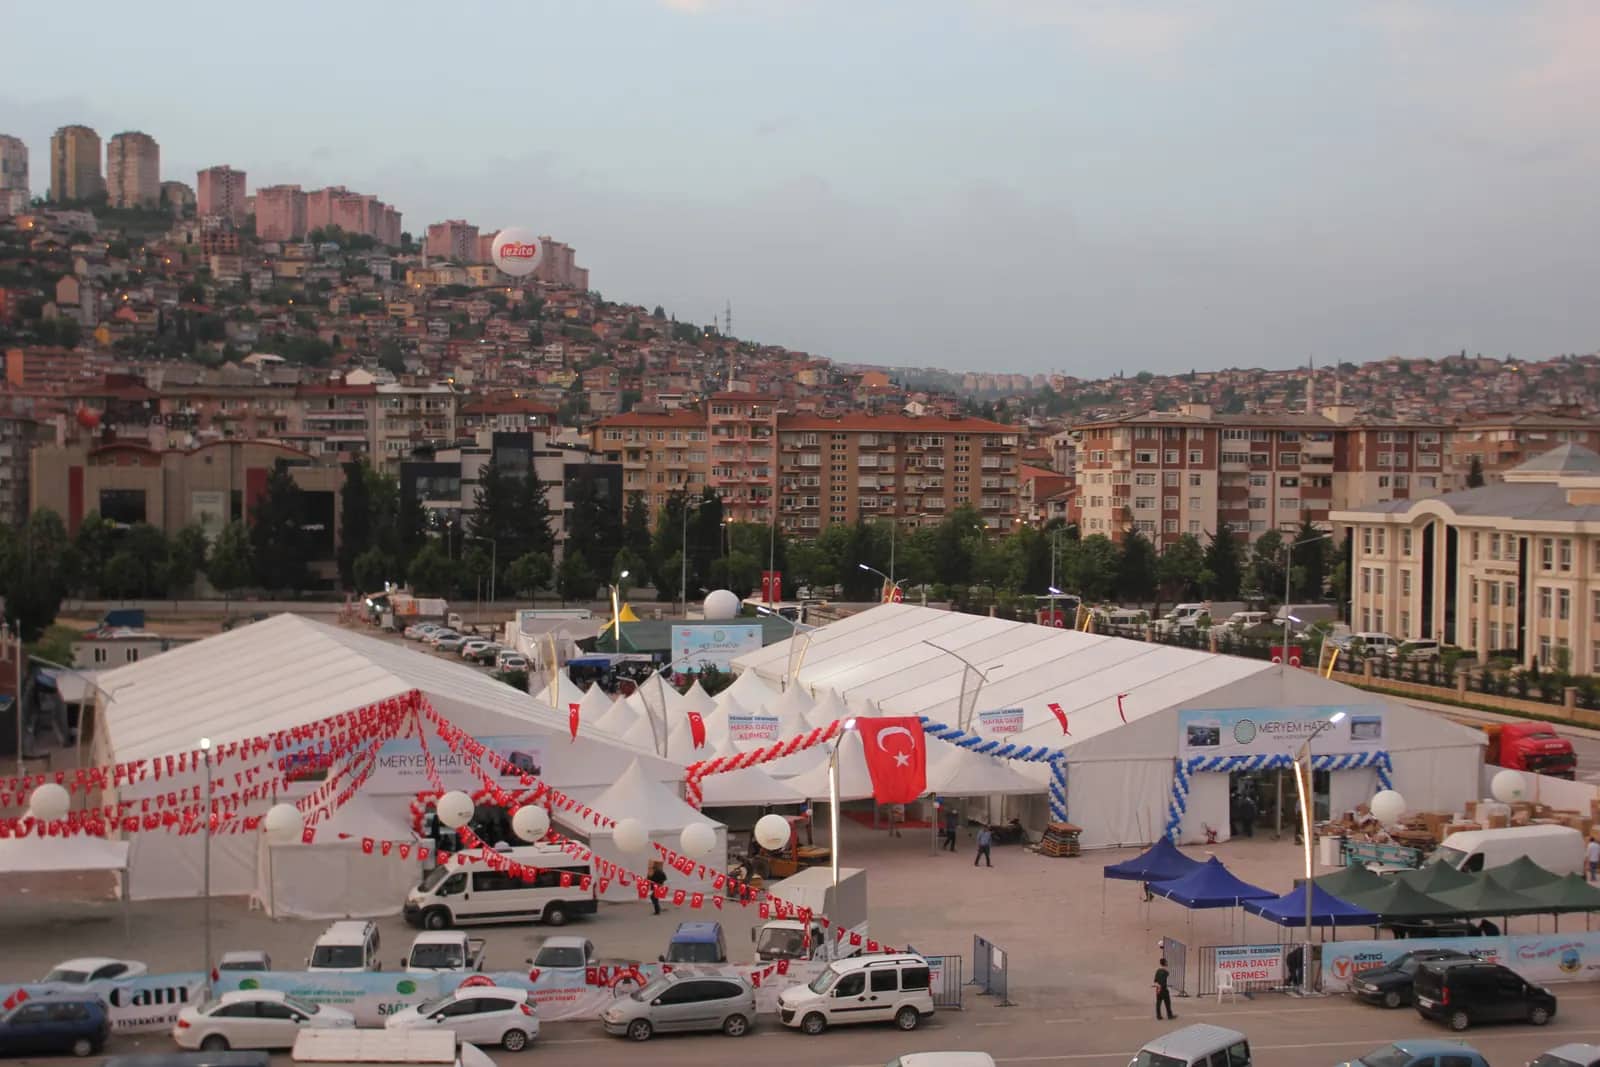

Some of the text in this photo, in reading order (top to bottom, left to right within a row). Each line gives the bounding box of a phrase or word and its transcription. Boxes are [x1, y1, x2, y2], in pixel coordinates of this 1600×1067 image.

[503, 245, 533, 256] lezita
[1259, 721, 1301, 733] MERYEM
[1219, 958, 1279, 969] HAYRA DAVET
[109, 987, 189, 1007] Cam
